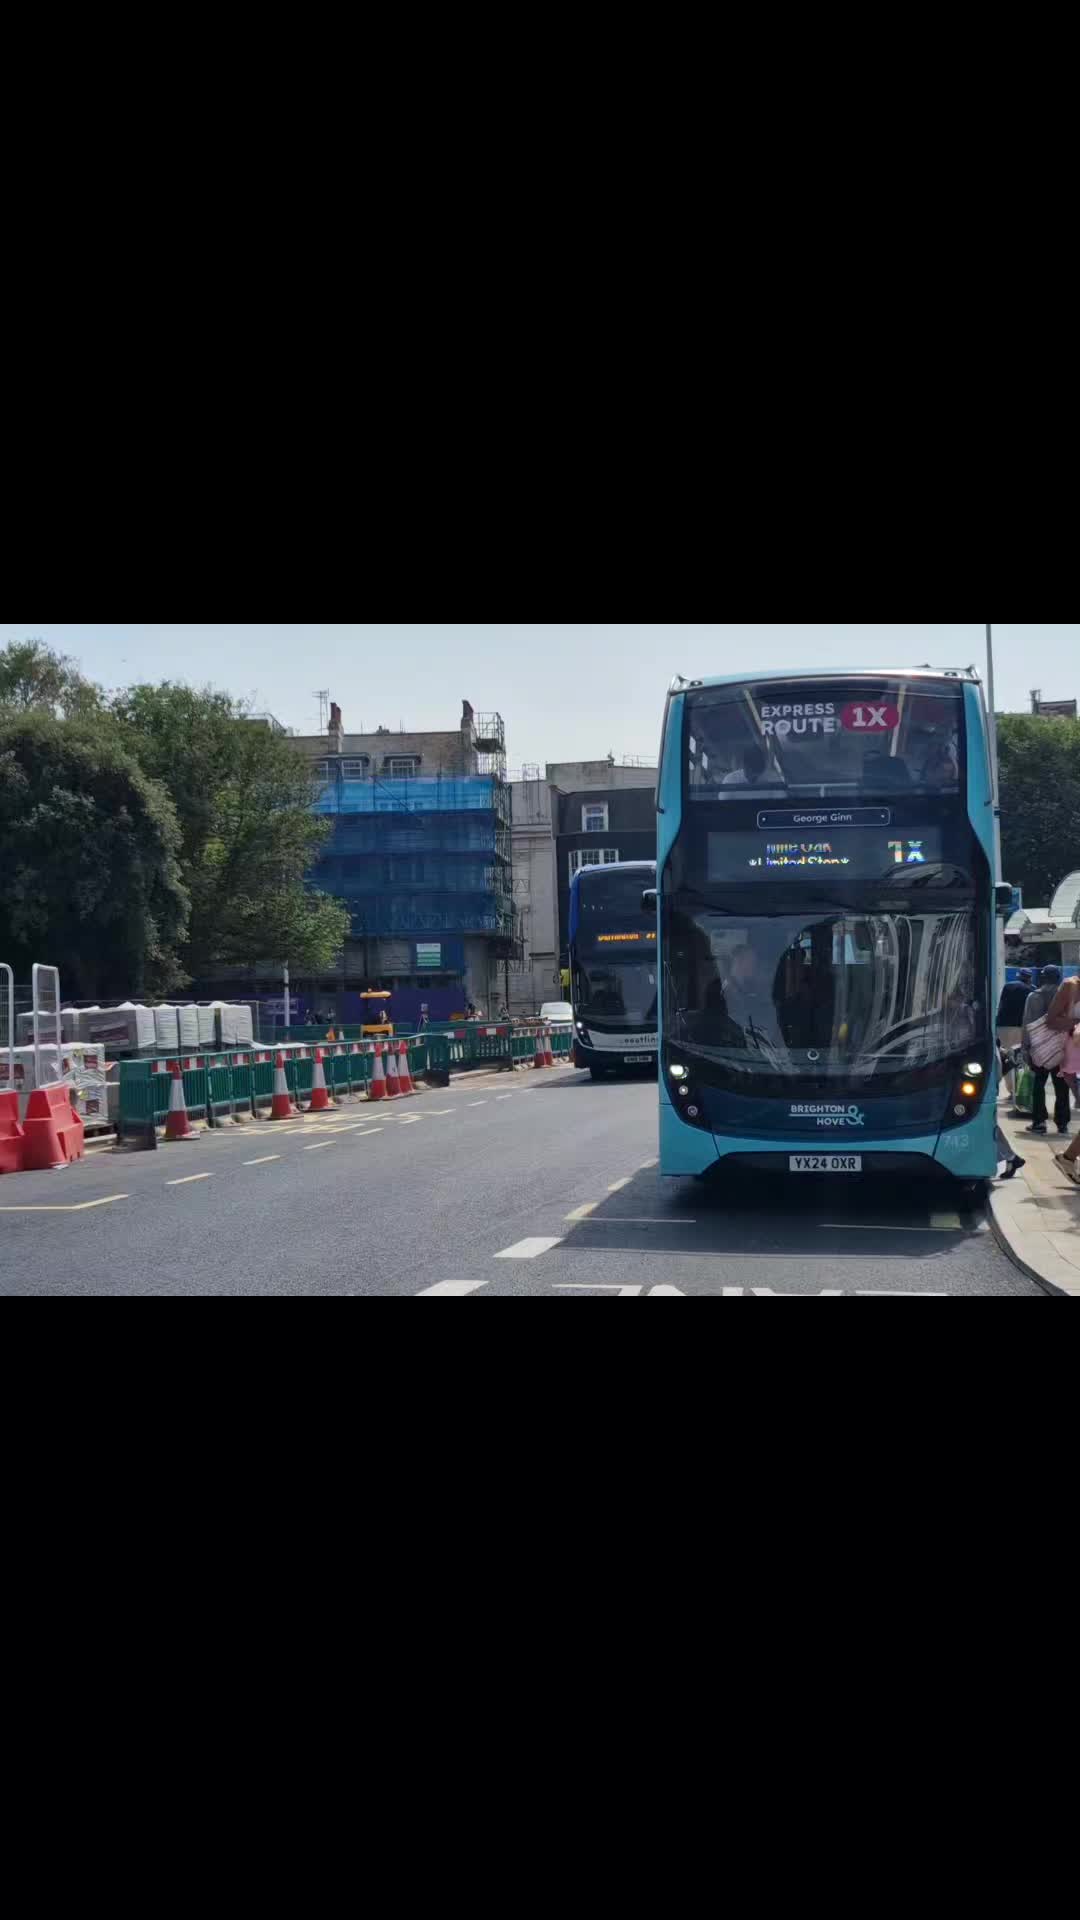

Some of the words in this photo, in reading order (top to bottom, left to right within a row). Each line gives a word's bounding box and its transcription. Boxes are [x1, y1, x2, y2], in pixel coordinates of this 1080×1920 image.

[761, 702, 835, 718] EXPRESS
[852, 707, 887, 727] 1X
[761, 717, 836, 735] ROUTE
[793, 814, 828, 824] George
[830, 813, 852, 823] Ginn
[887, 841, 926, 863] 1X
[790, 1104, 845, 1114] BRIGHTON
[816, 1117, 846, 1127] HOVE
[794, 1157, 828, 1170] YX24
[831, 1157, 857, 1170] OXR
